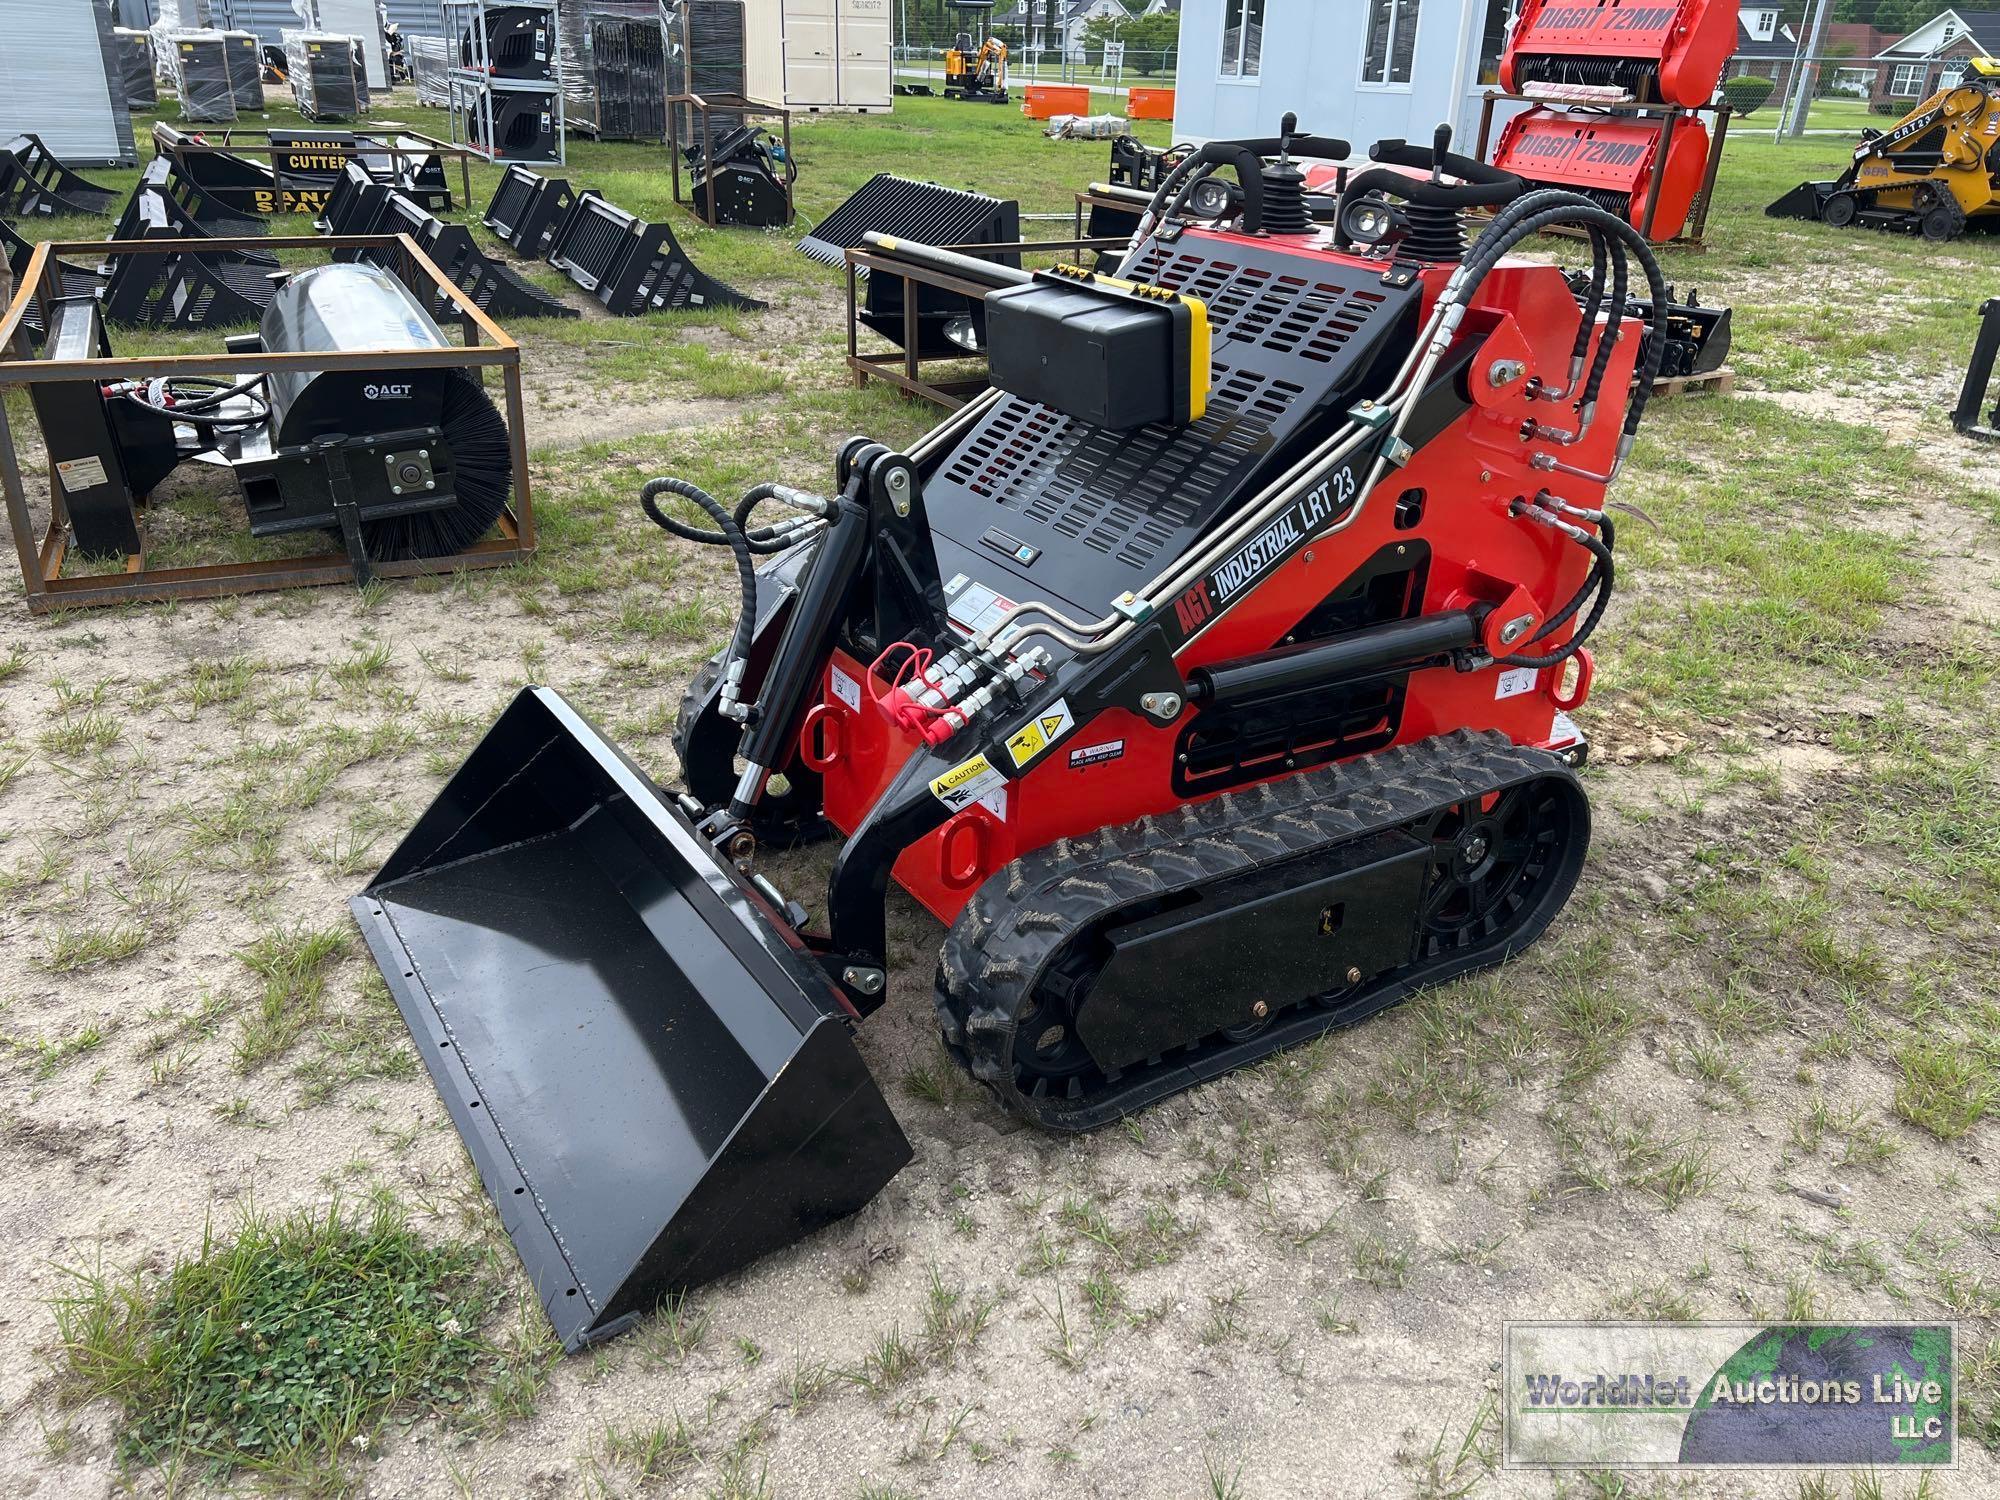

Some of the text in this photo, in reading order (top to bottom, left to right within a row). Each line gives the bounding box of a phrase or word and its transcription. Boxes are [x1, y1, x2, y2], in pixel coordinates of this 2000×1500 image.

[1534, 7, 1677, 31] DIGGIT 72MM
[1893, 115, 1931, 140] CRT23
[289, 155, 347, 169] CUTTER
[1513, 134, 1647, 167] DIGGIT 72MM
[380, 384, 412, 394] AGT
[1174, 465, 1356, 635] AGT INDUSTRIAL LRT 23
[948, 761, 985, 784] CAUTION
